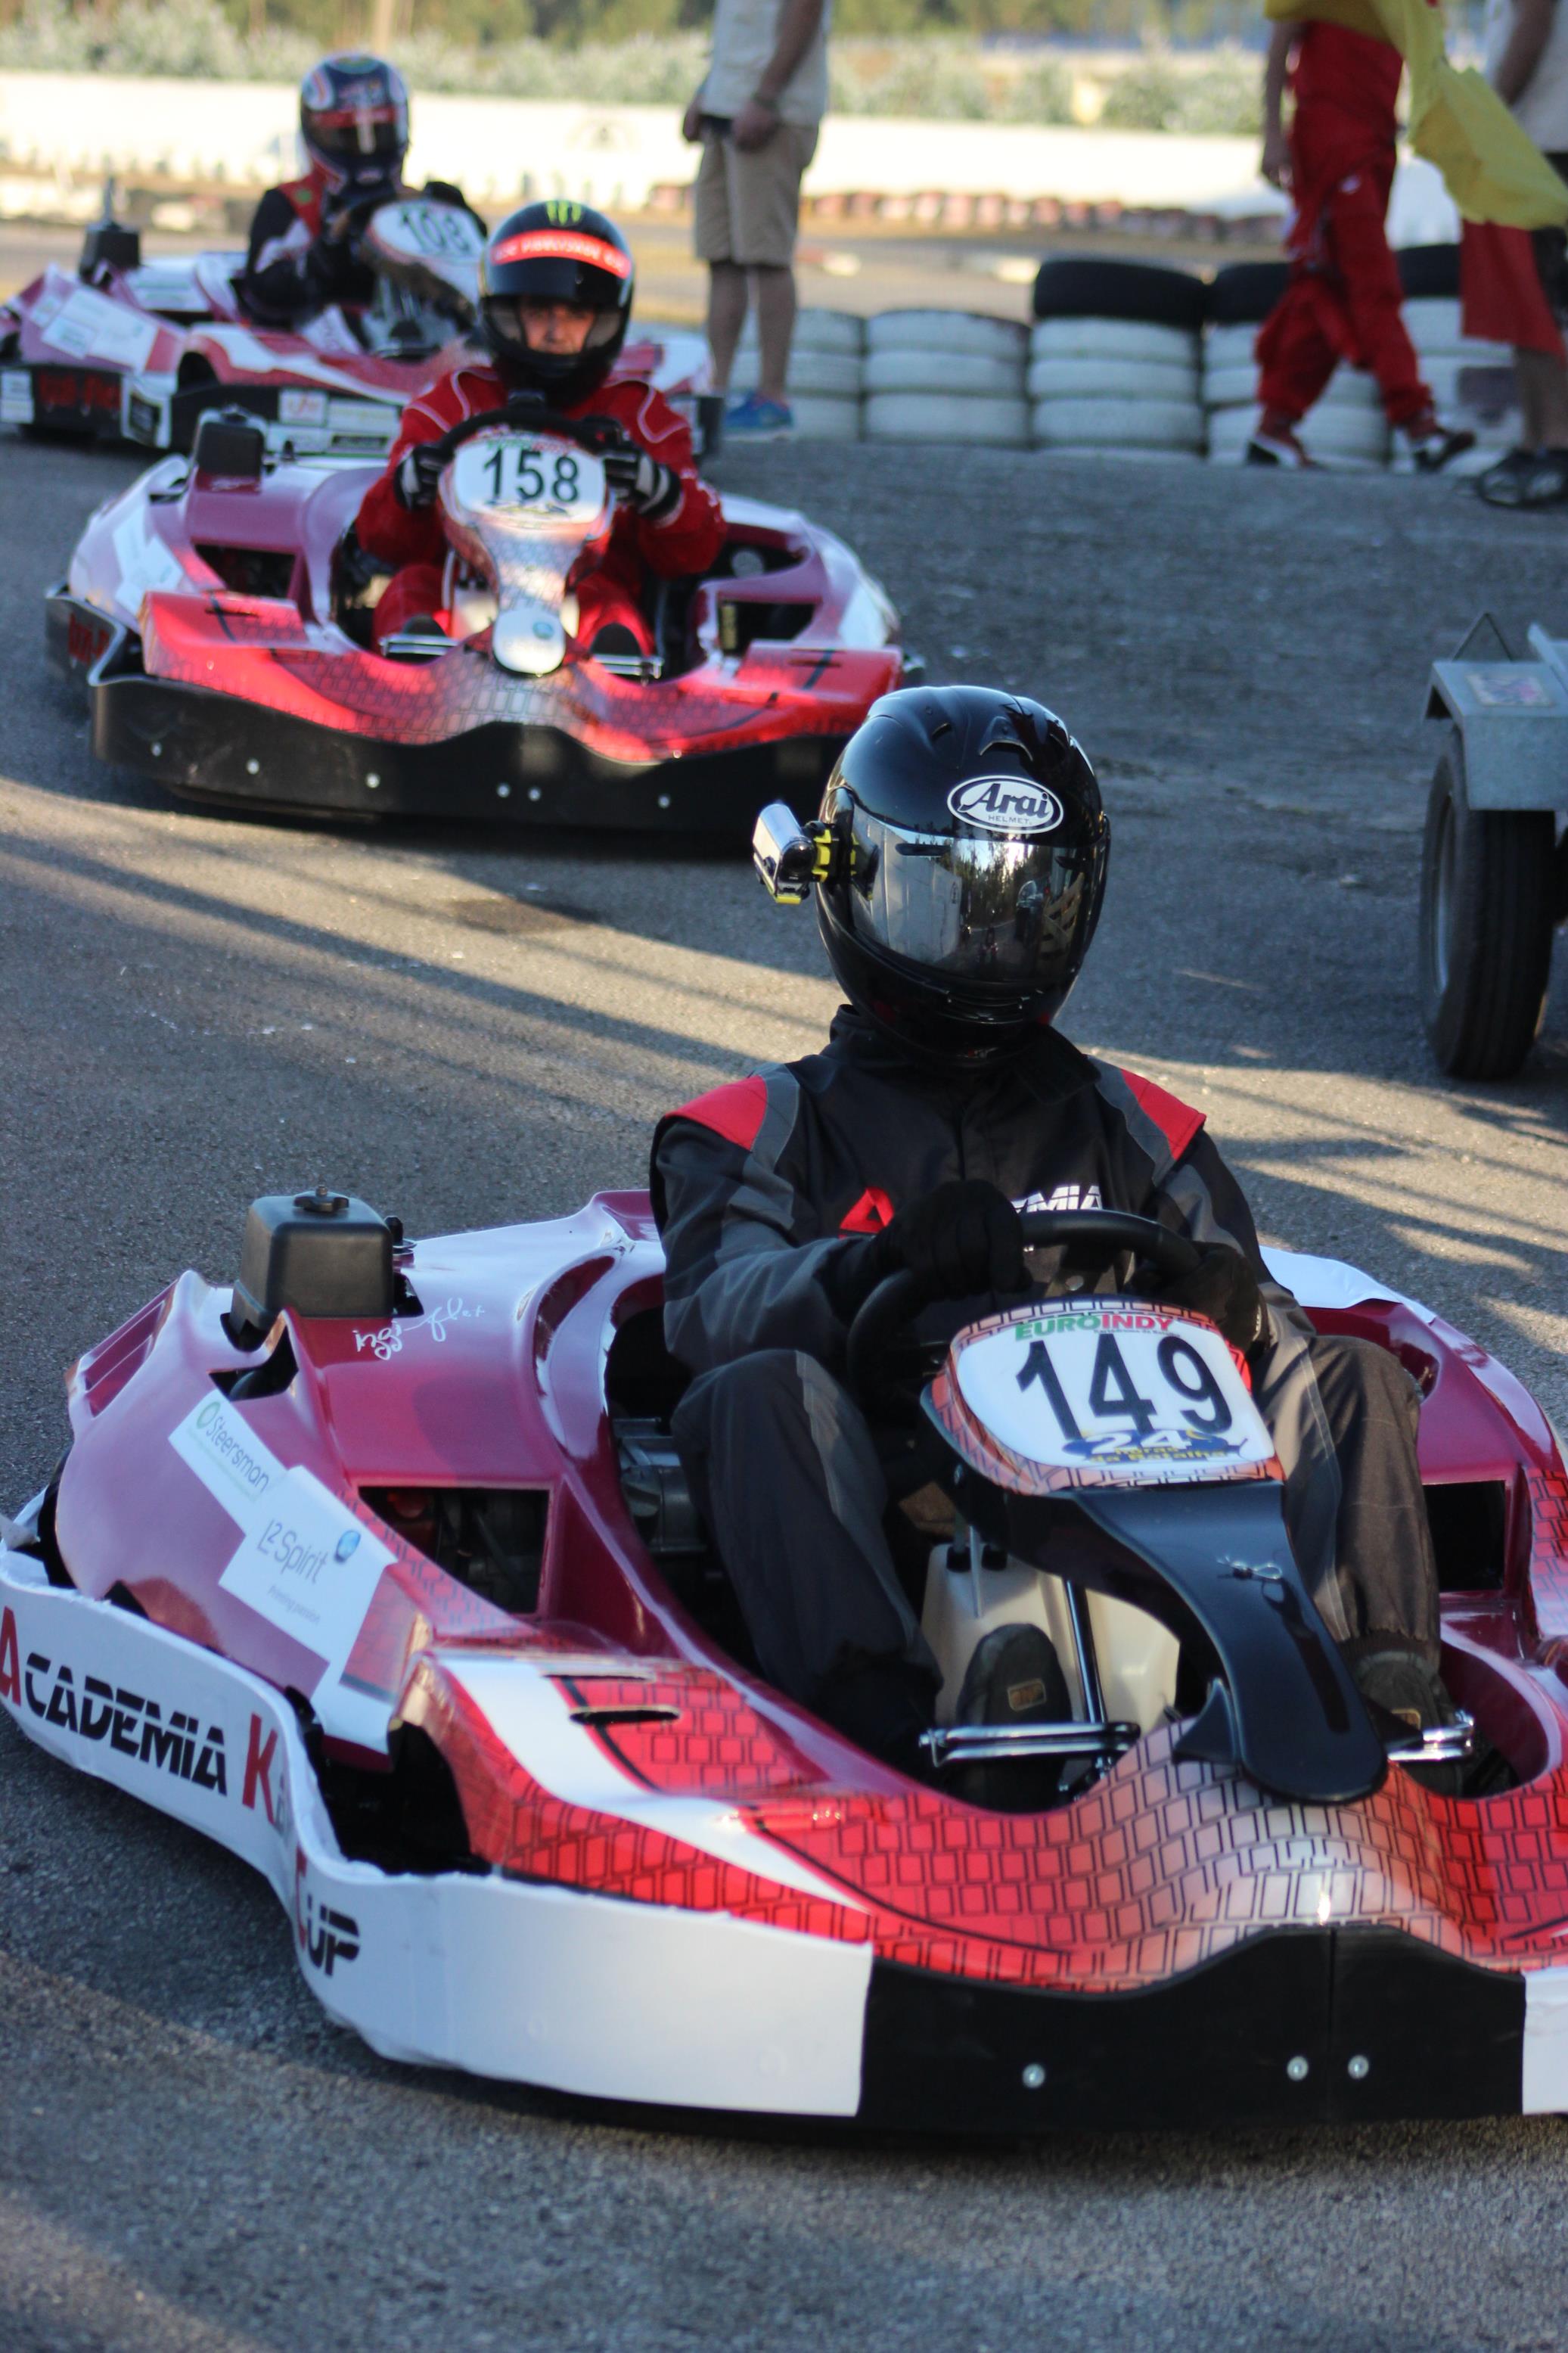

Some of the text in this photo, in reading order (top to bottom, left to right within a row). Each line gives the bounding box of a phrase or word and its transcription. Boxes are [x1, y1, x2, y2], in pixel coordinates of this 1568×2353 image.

[483, 449, 579, 502] 158
[958, 783, 1051, 819] Arai
[1015, 1313, 1172, 1341] EUROINDY
[1015, 1332, 1233, 1438] 149
[206, 1416, 269, 1494] Steersman
[1085, 1429, 1193, 1454] 24
[0, 1605, 227, 1797] ACADEMIA
